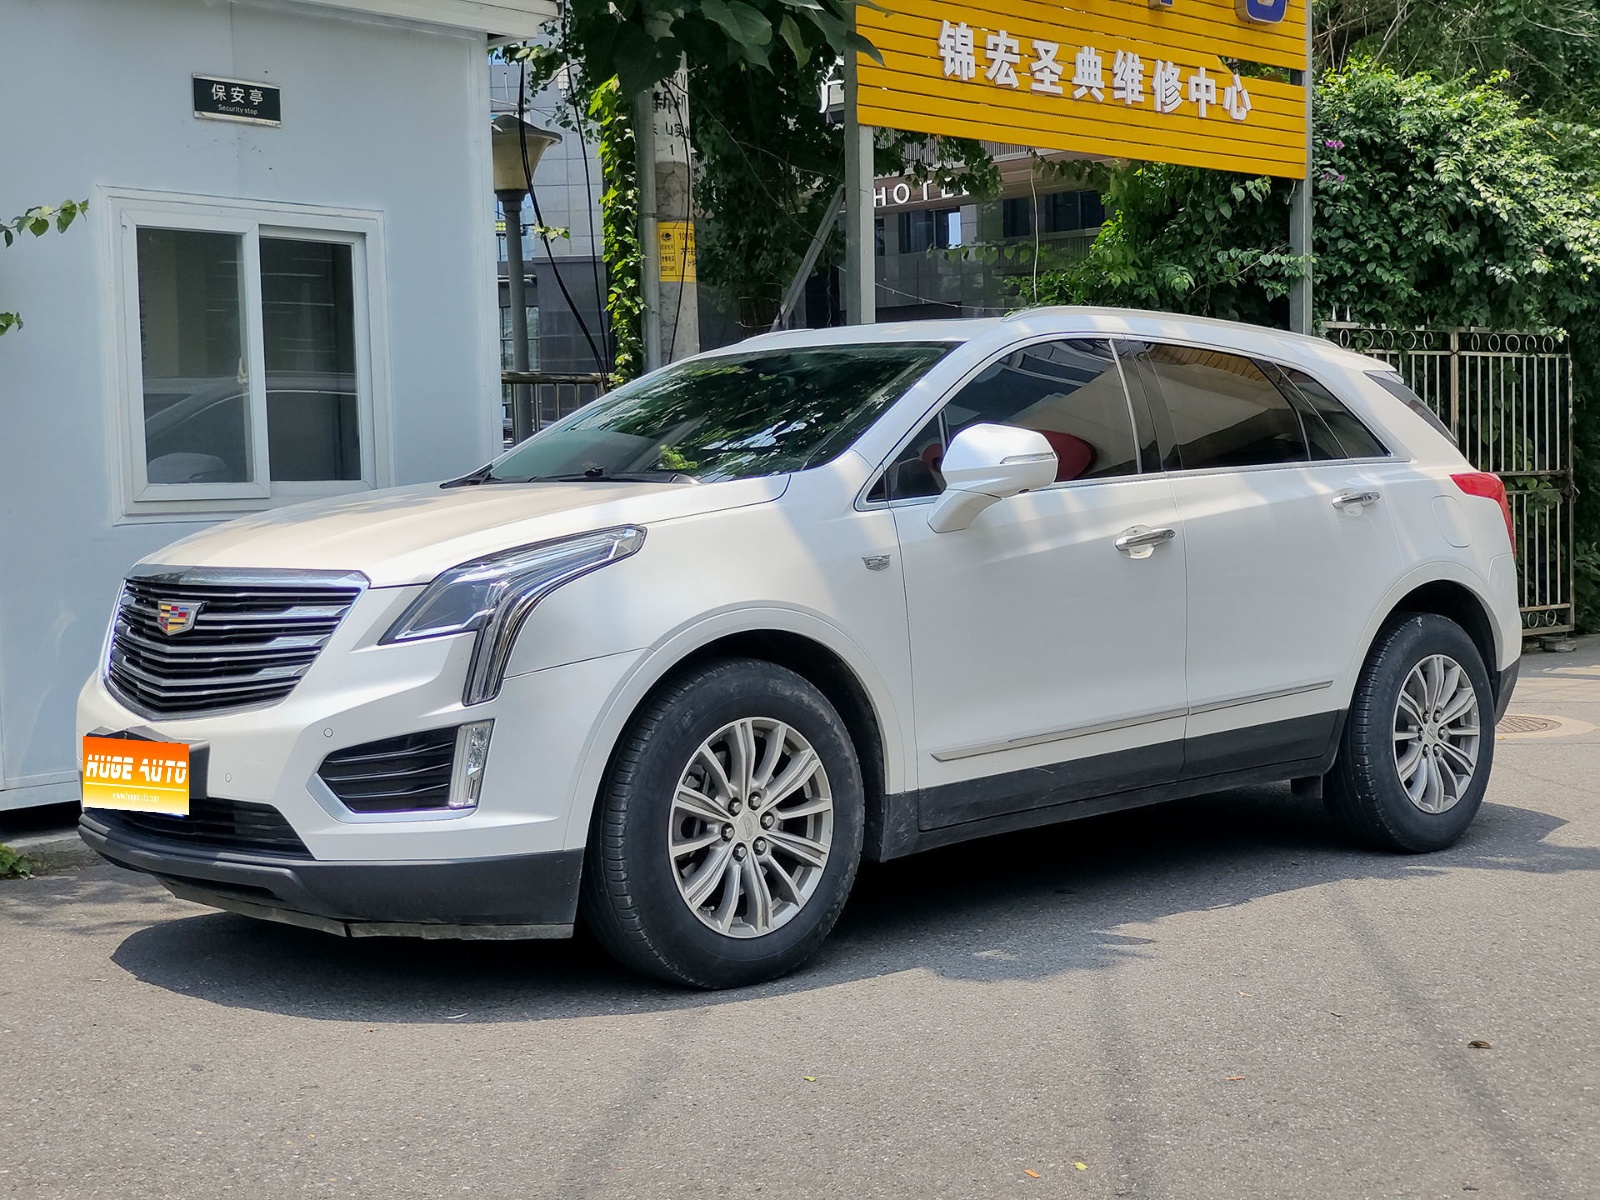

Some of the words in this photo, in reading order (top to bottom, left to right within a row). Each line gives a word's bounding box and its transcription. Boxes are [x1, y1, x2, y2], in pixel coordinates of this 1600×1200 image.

[938, 19, 1252, 121] 锦宏圣典维修中心
[211, 83, 264, 105] 保安亭
[218, 103, 243, 114] Security
